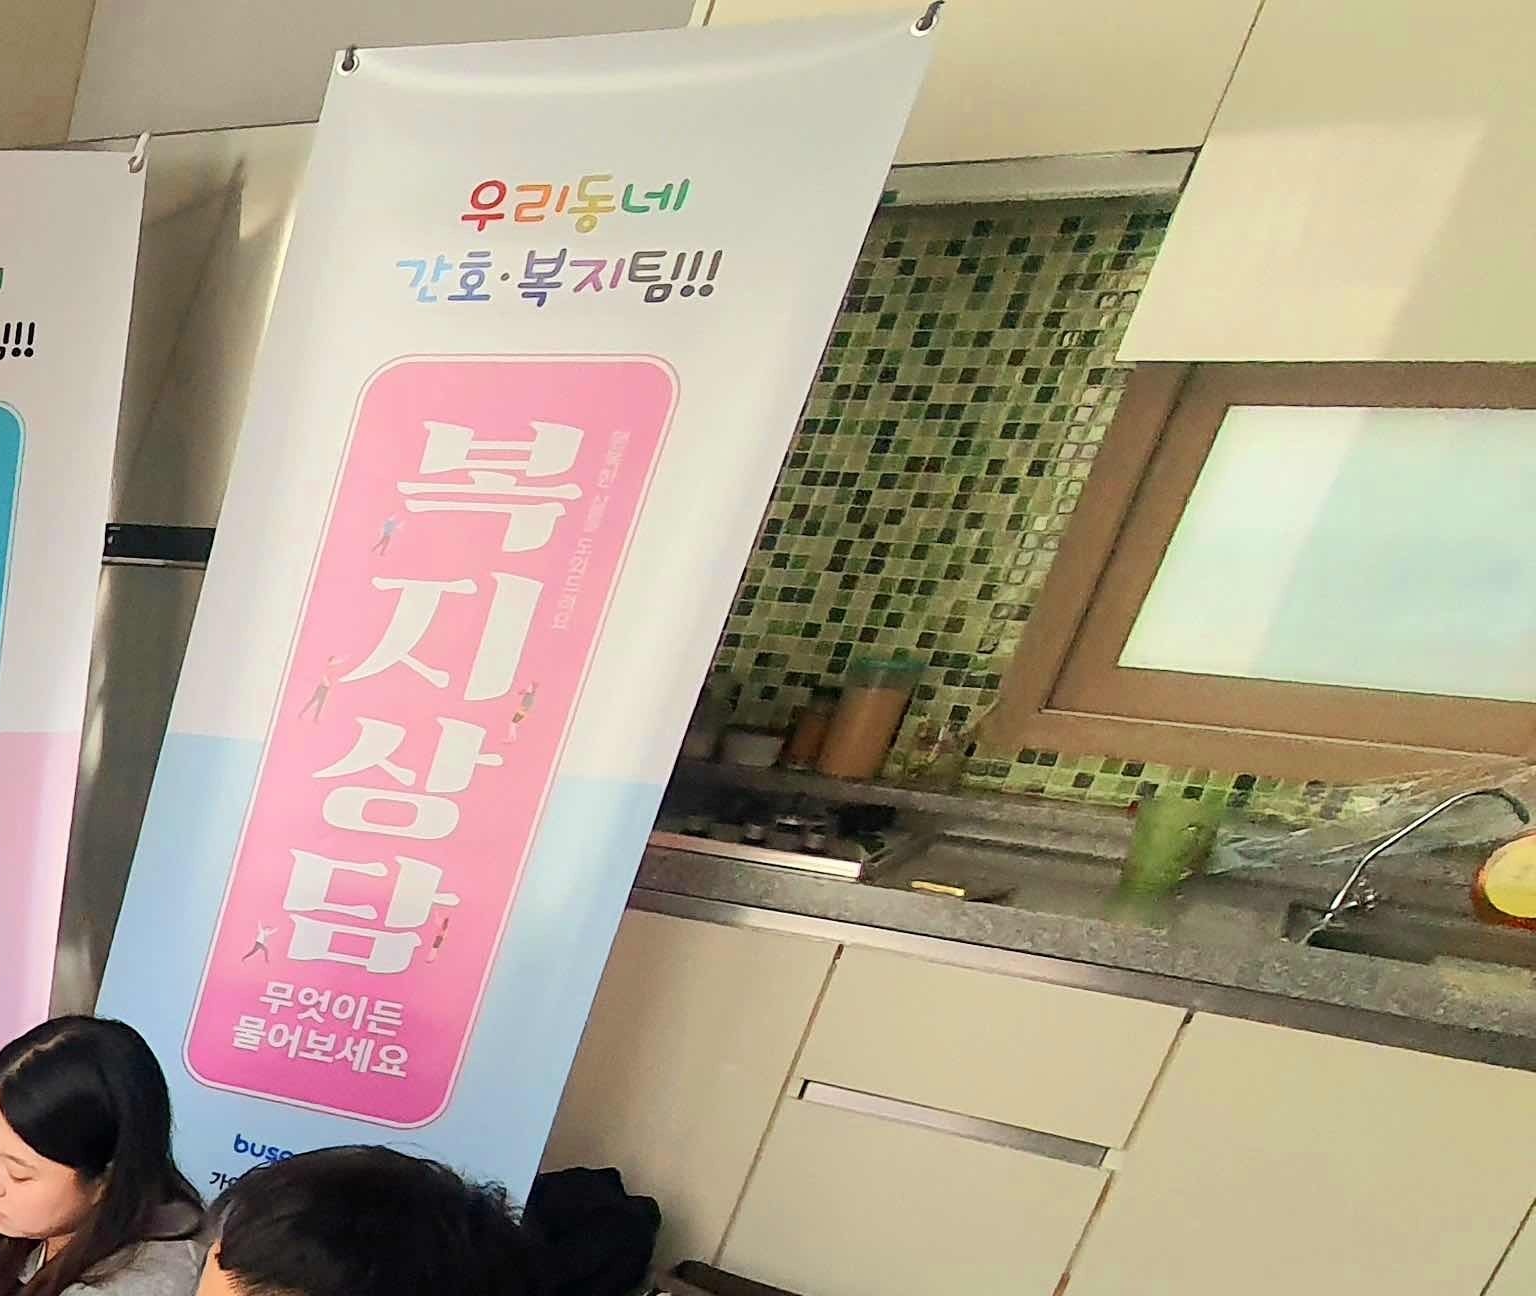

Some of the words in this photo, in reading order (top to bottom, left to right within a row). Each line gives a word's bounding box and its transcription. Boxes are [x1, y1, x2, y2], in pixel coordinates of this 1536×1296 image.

[460, 173, 691, 233] 우리동네
[282, 420, 584, 974] 복지상담
[259, 981, 404, 1038] 무엇이든
[231, 1017, 410, 1080] 물어보세요
